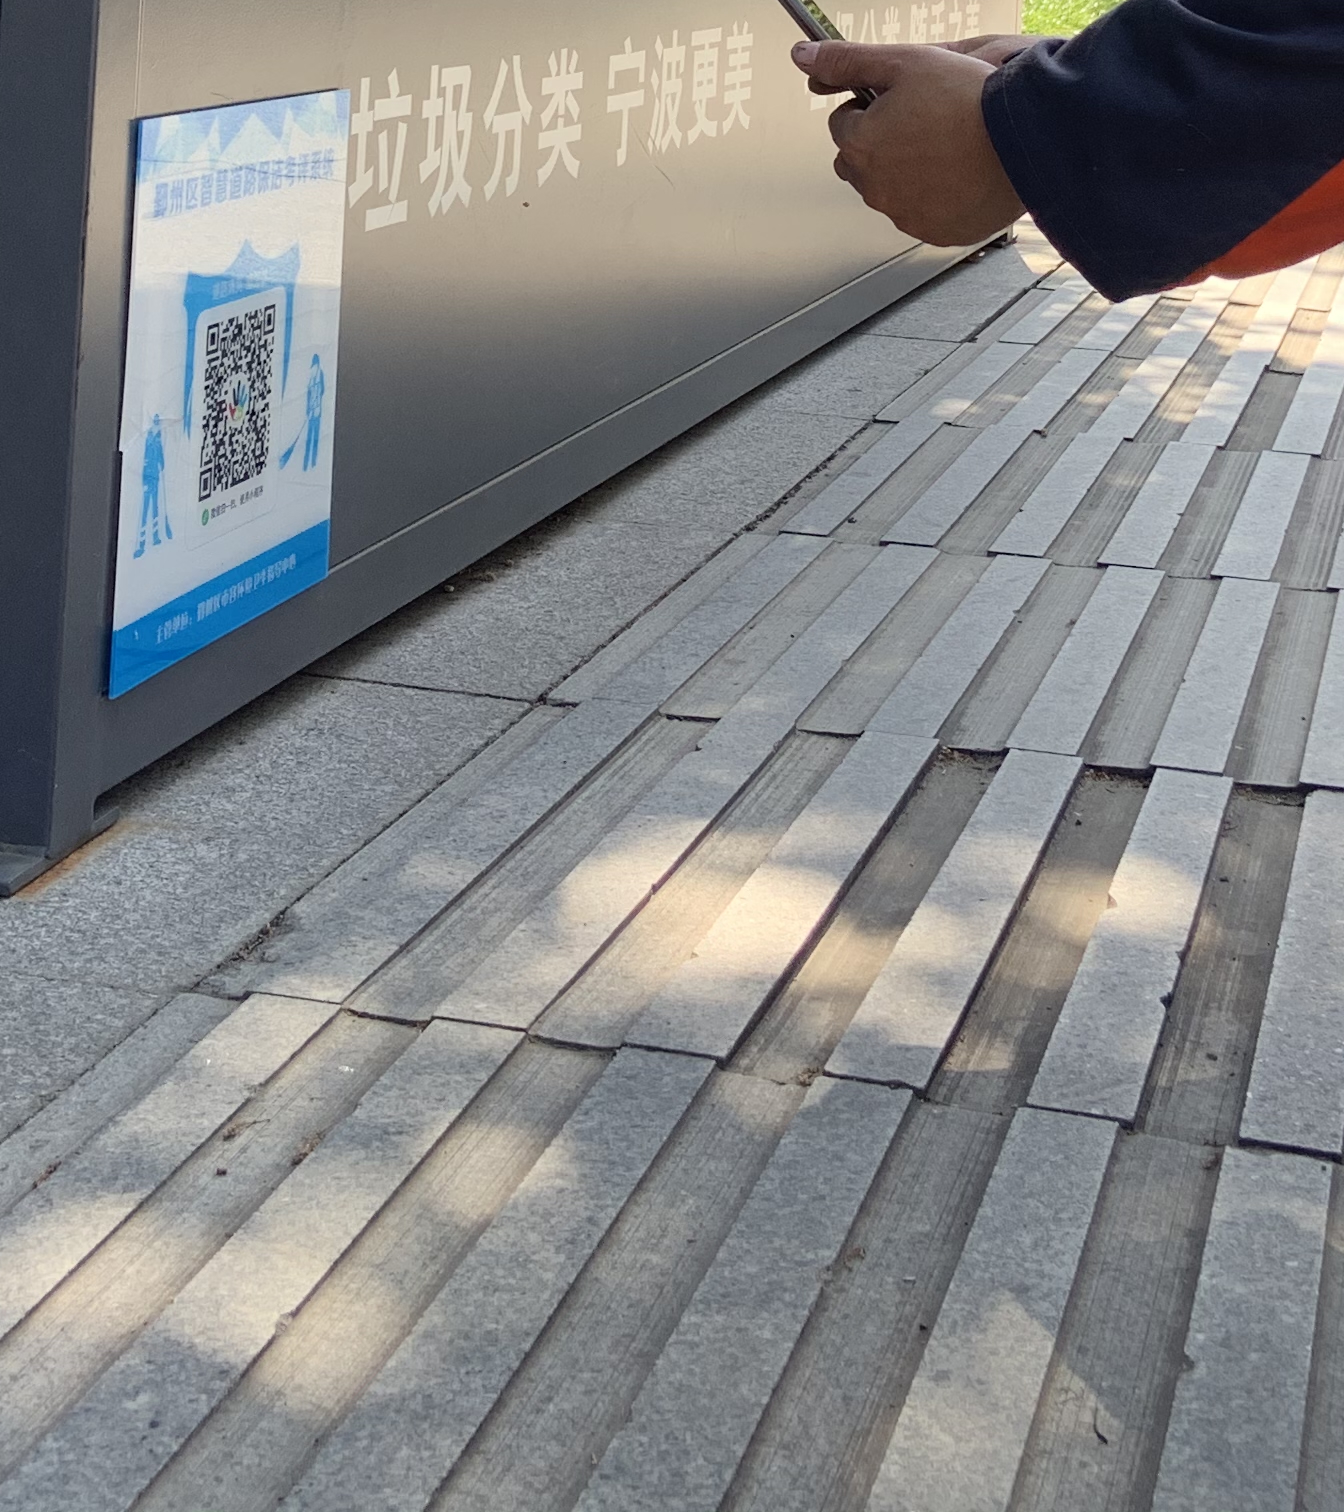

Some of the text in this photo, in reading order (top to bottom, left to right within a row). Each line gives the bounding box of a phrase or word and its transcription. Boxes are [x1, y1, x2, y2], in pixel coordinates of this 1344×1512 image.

[348, 46, 583, 231] 垃圾分类
[607, 21, 754, 168] 宁波更美
